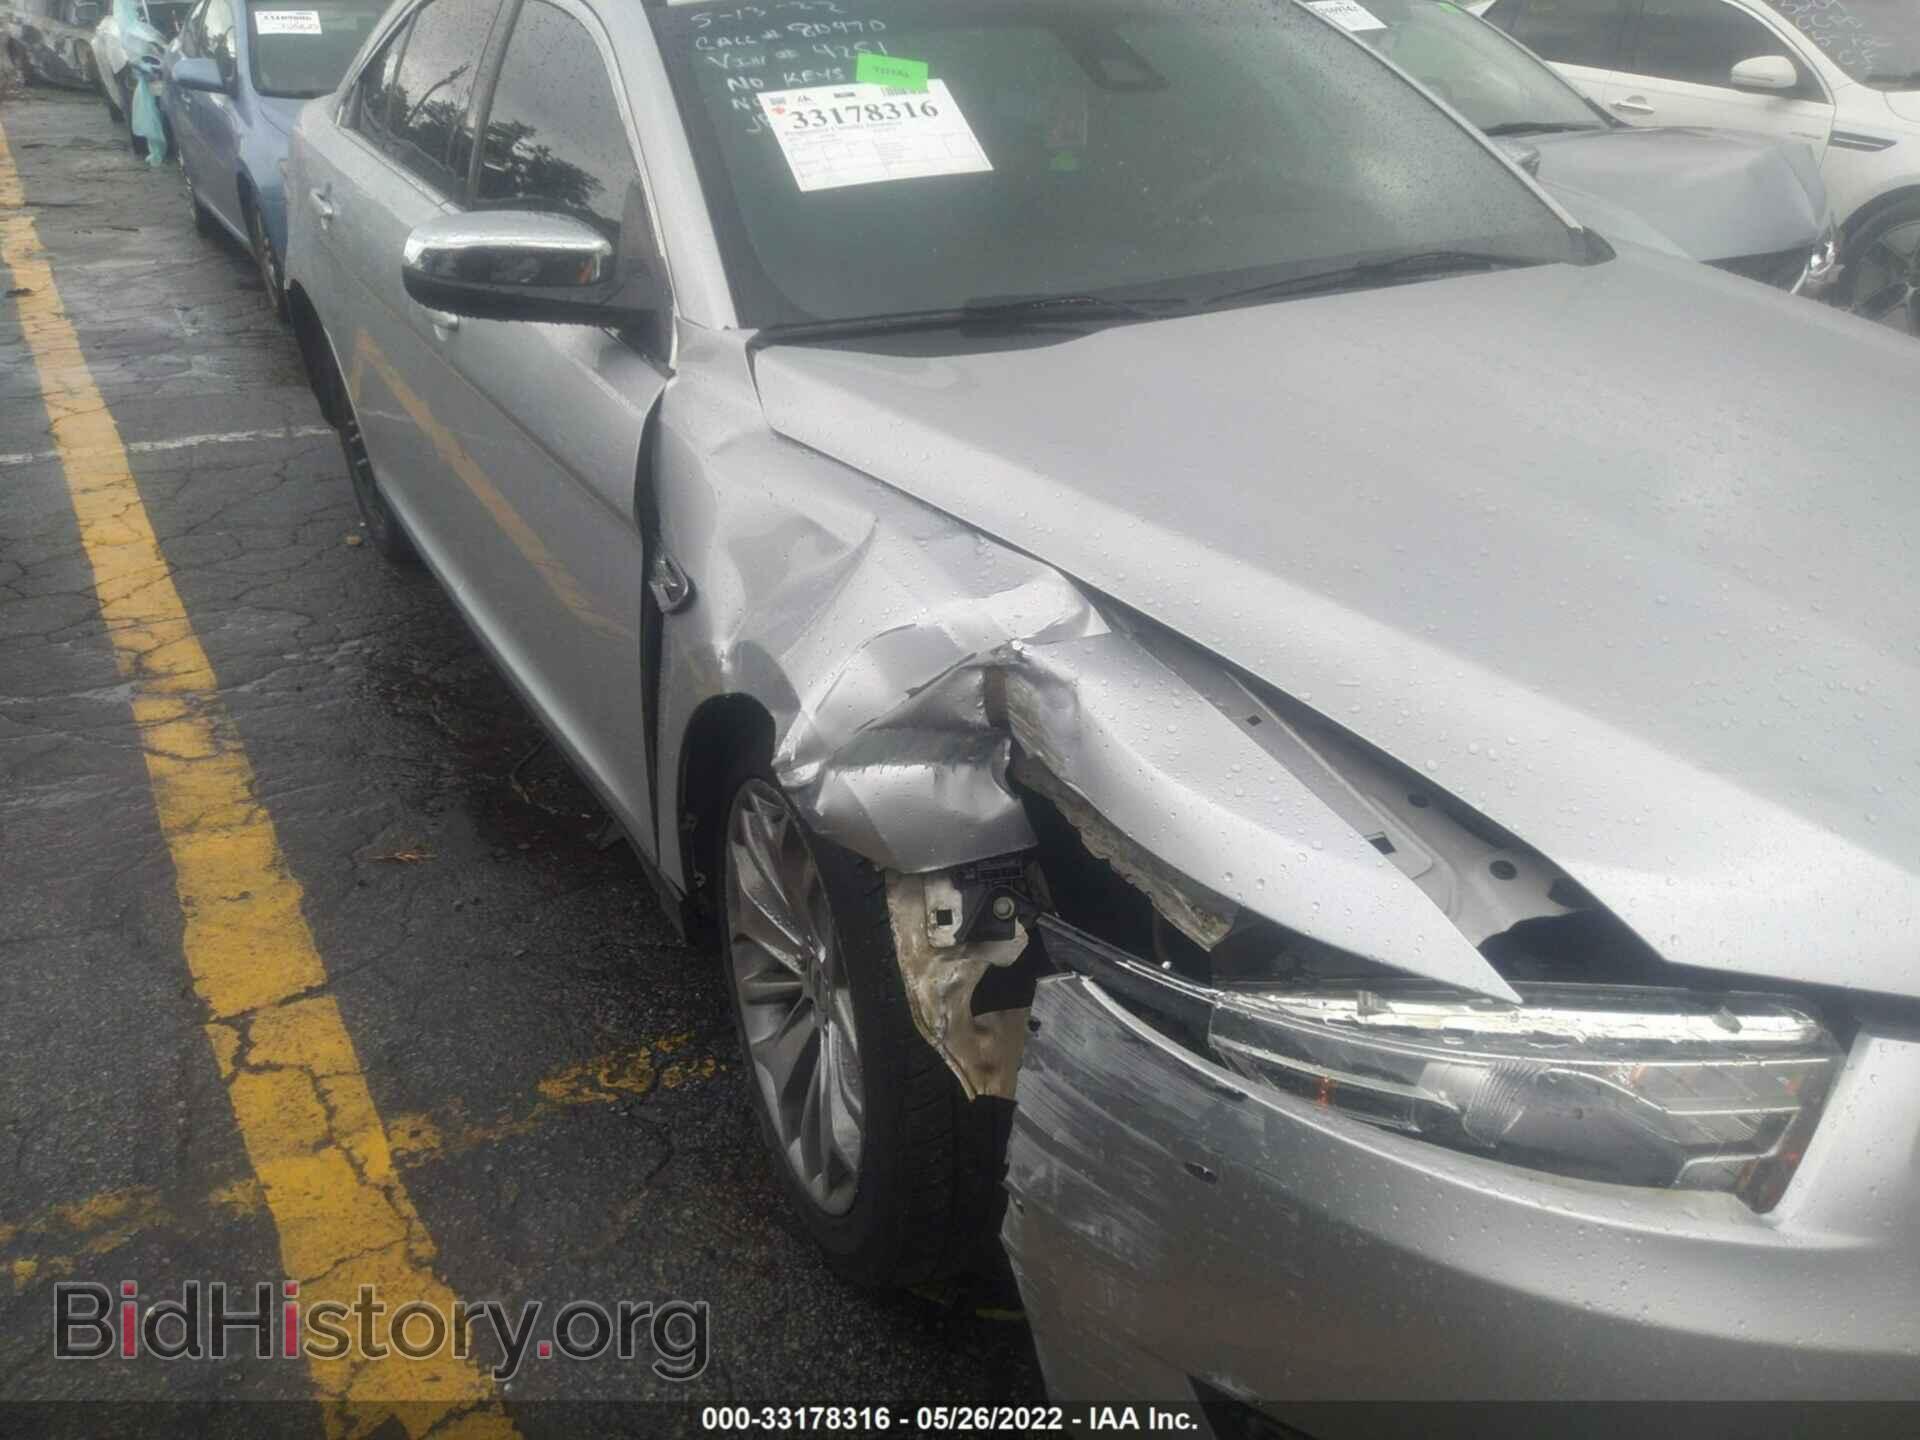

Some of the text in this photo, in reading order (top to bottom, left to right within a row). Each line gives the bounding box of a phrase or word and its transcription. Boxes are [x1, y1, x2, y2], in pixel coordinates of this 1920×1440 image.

[696, 35, 759, 50] CALL
[727, 67, 846, 92] NO KEYS
[789, 99, 939, 129] 33178316
